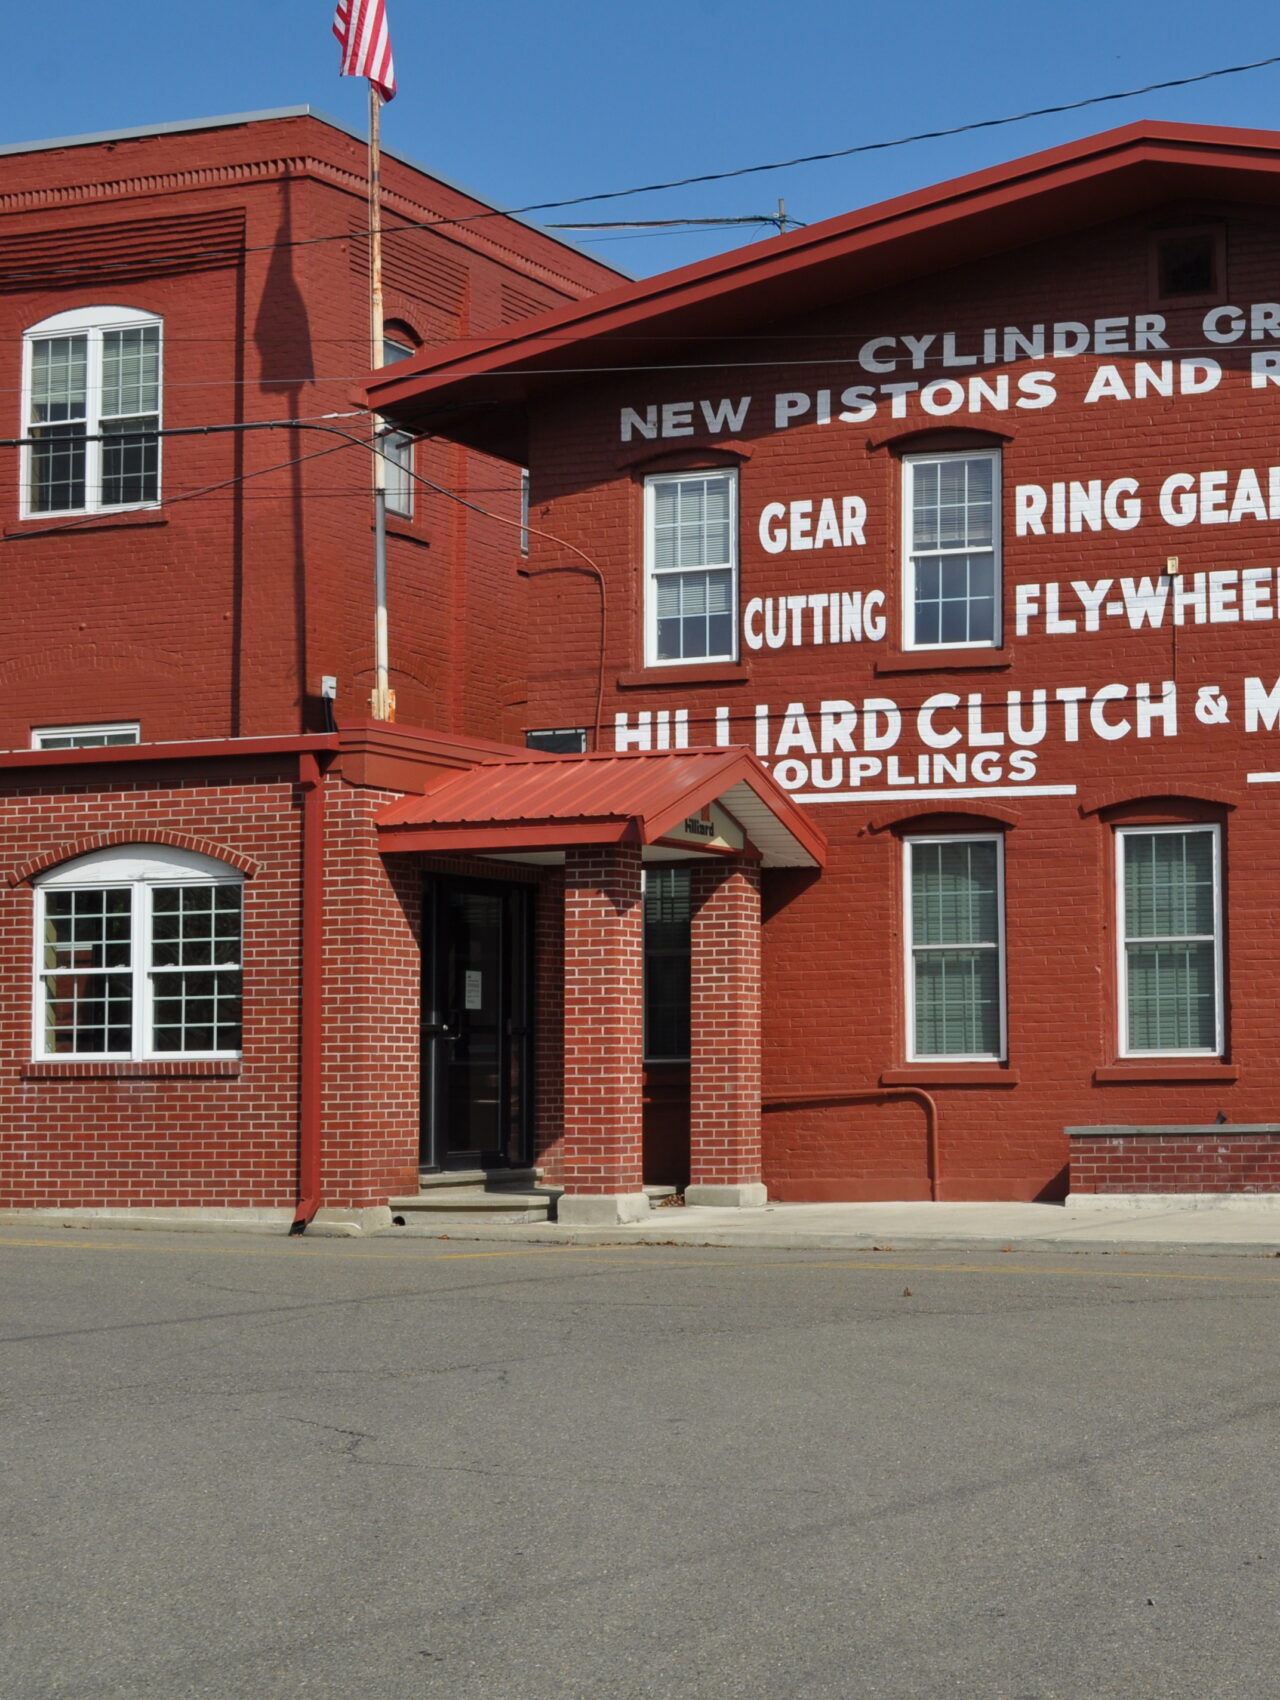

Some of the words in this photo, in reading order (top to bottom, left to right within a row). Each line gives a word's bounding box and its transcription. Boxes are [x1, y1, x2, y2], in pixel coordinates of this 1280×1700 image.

[858, 314, 1180, 373] CYLINDER
[621, 397, 751, 441] NEW
[775, 371, 1057, 428] PISTONS
[1084, 358, 1222, 403] AND
[759, 496, 867, 554] GEAR
[1015, 478, 1142, 537] RING
[743, 590, 887, 650] CUTTING
[917, 680, 1179, 749] CLUTCH
[1195, 686, 1230, 725] &
[761, 749, 1038, 790] OUPLINGS
